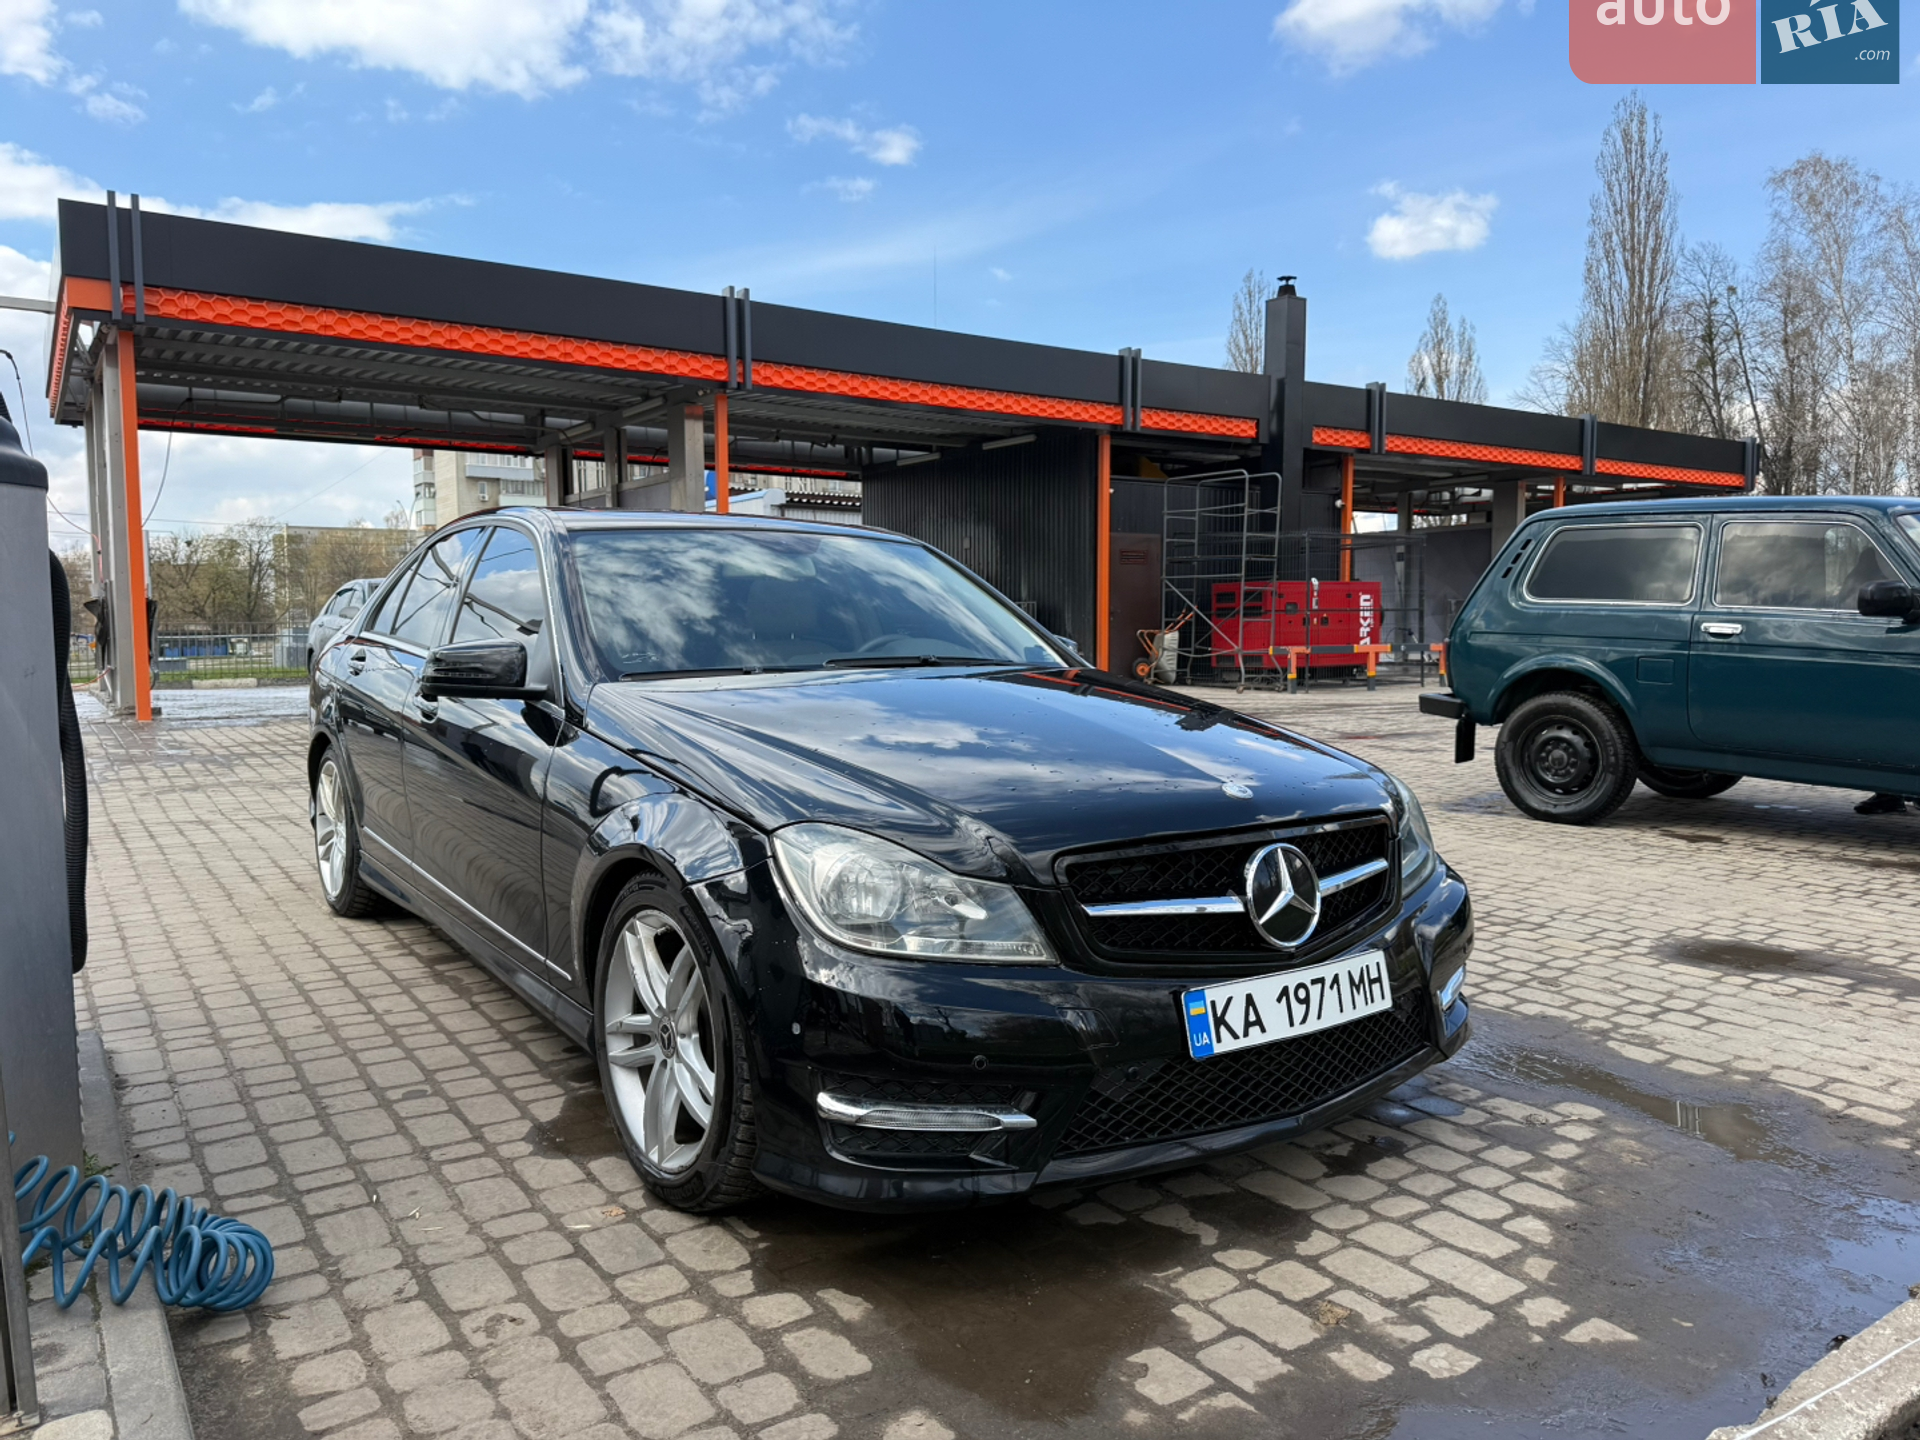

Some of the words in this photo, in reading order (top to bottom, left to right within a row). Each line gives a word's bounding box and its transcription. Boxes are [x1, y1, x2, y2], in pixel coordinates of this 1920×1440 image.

[1210, 993, 1267, 1044] KA
[1276, 973, 1344, 1028] 1971
[1347, 961, 1385, 1010] MH
[1193, 1032, 1211, 1047] UA
